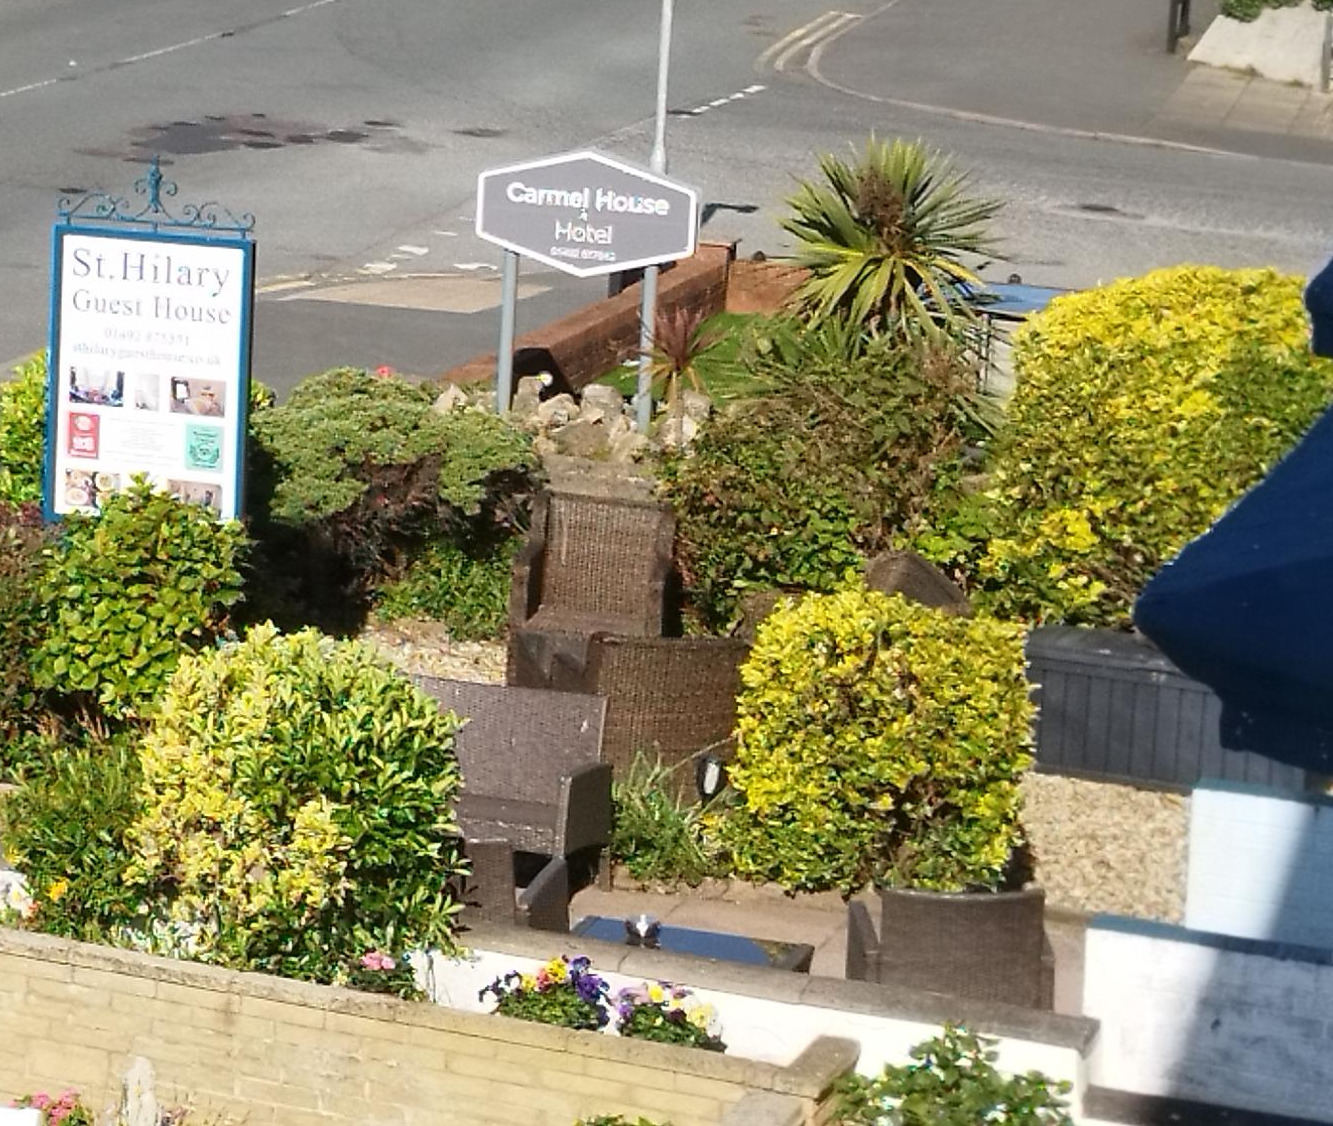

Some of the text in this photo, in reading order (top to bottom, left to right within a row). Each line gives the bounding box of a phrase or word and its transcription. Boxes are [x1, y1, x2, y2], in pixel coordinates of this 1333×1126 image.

[506, 181, 671, 216] Carmel House
[555, 220, 613, 245] Hotel
[72, 288, 232, 325] Guest House
